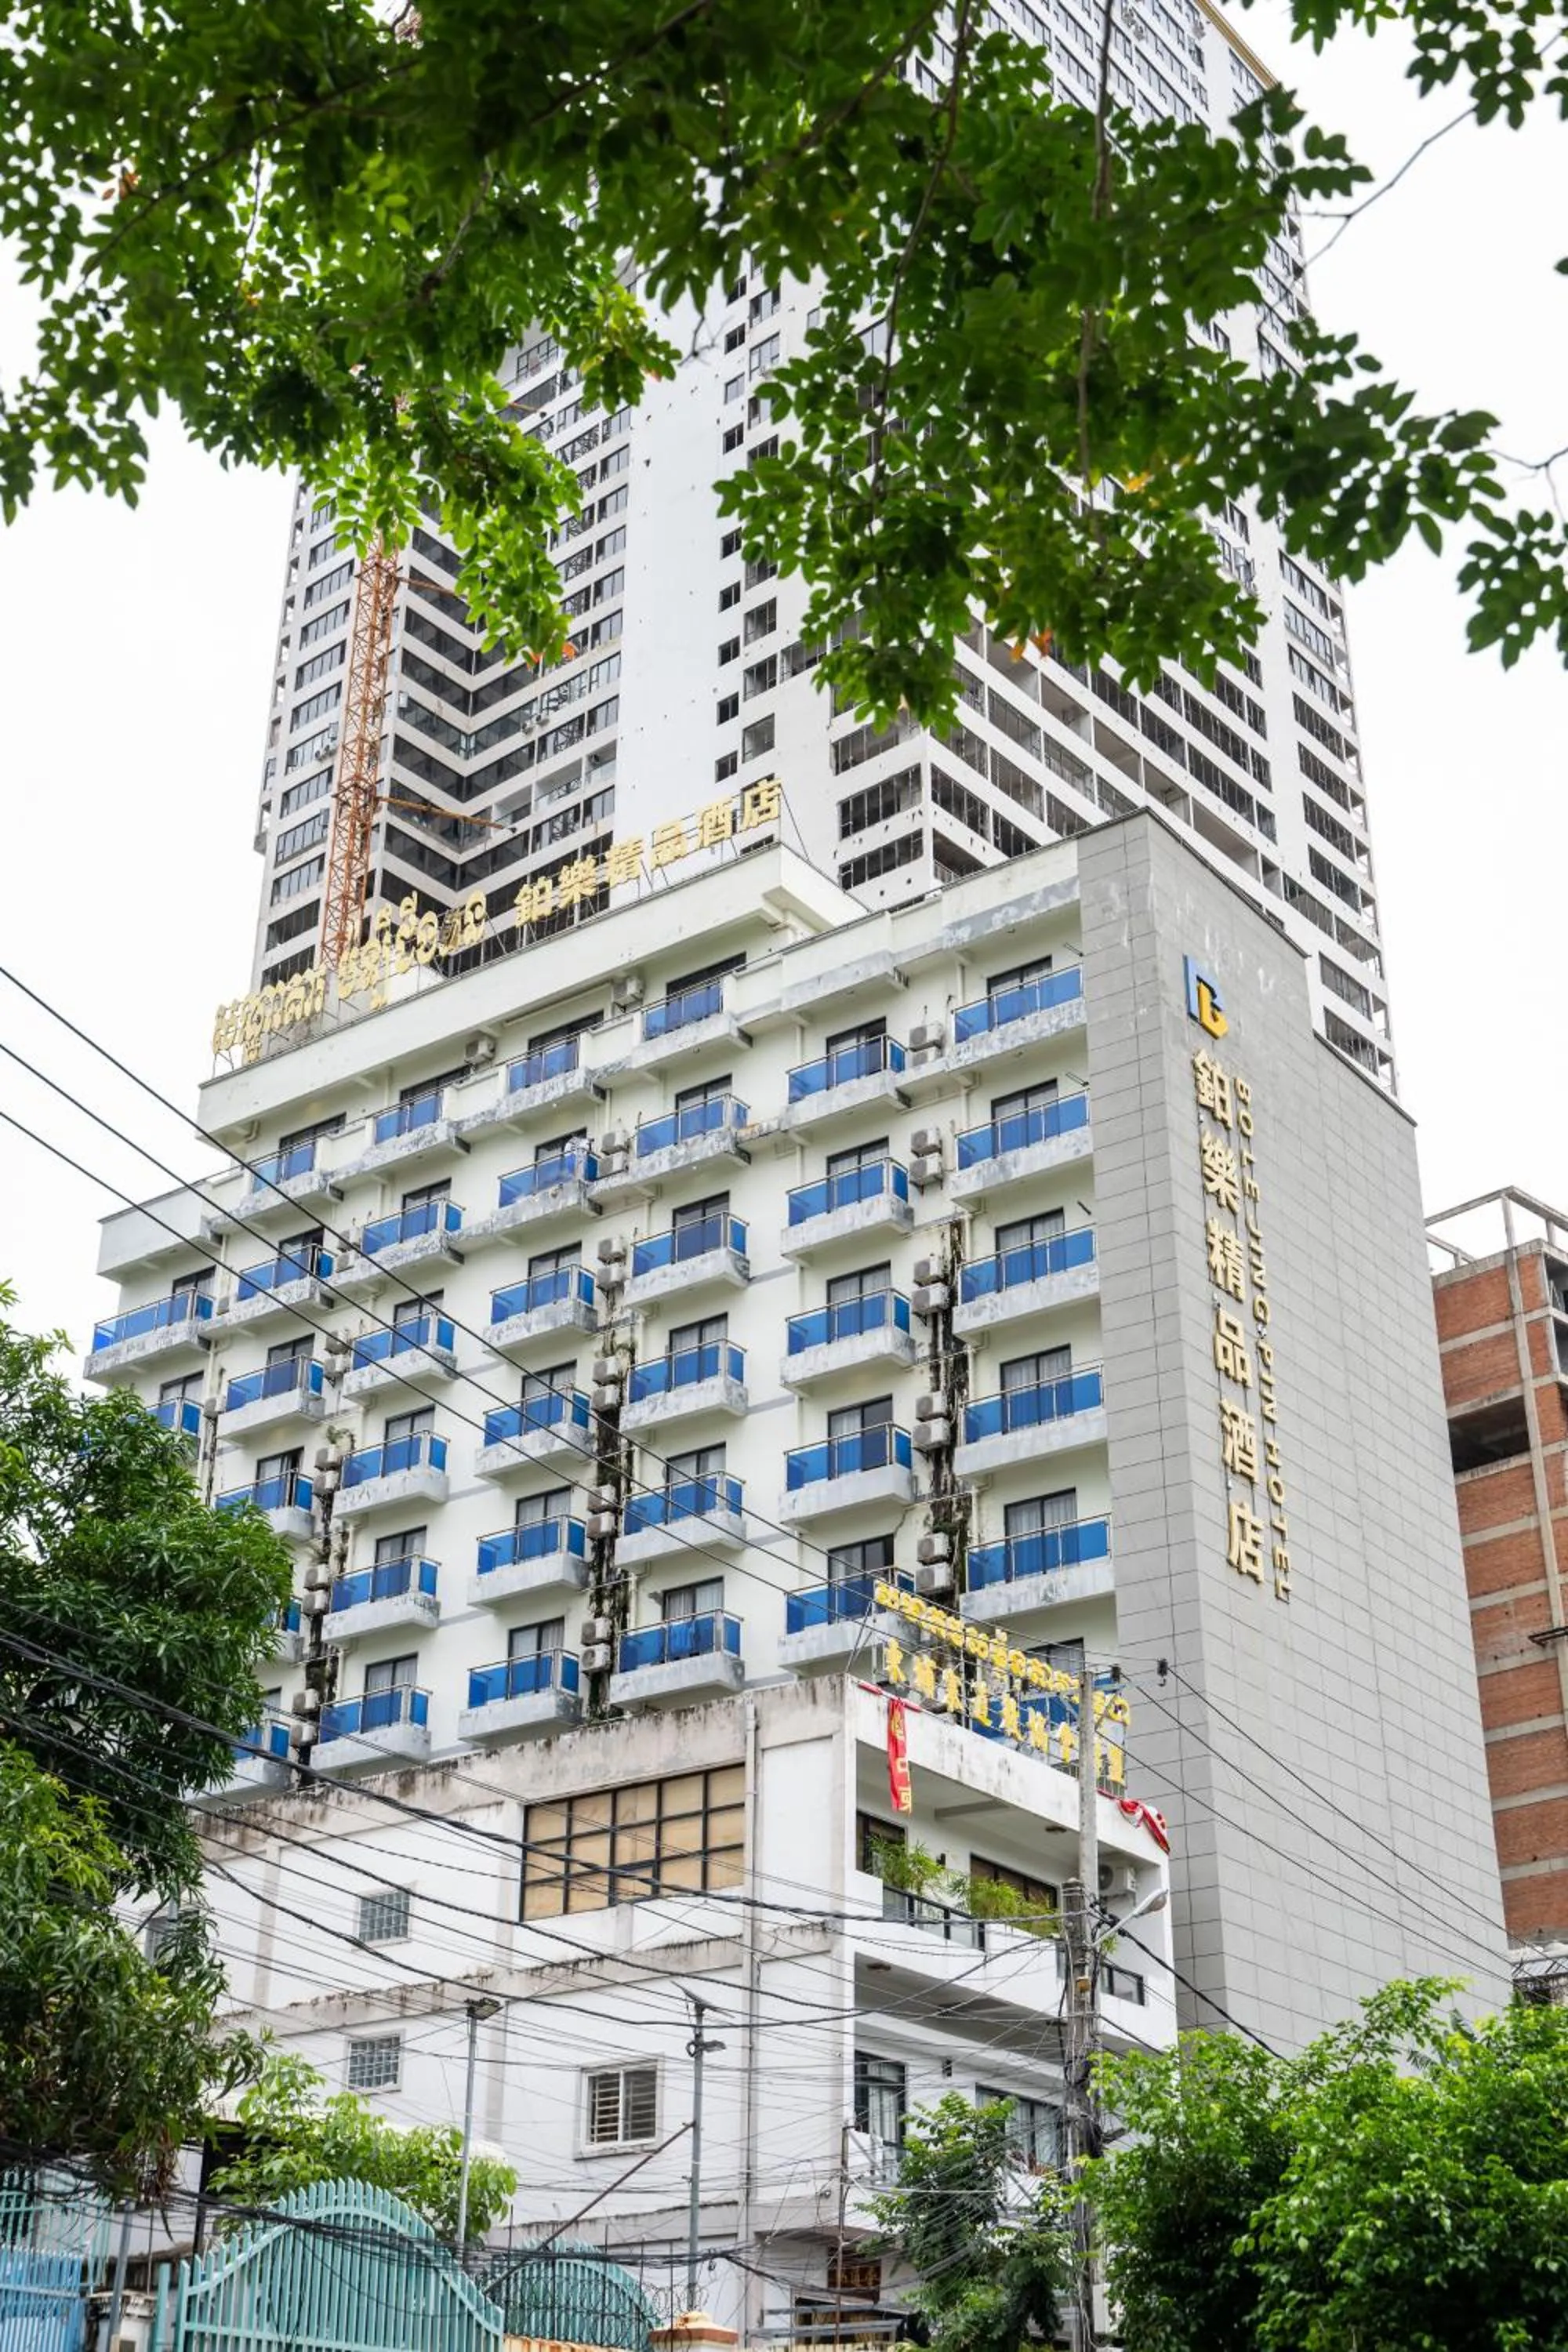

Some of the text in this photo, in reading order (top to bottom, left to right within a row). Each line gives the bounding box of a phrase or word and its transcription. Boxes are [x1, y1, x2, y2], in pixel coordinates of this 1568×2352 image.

[1192, 1047, 1265, 1584] 鉑樂精品酒店
[1256, 1339, 1278, 1425] PIN
[1264, 1438, 1293, 1605] HOTEL
